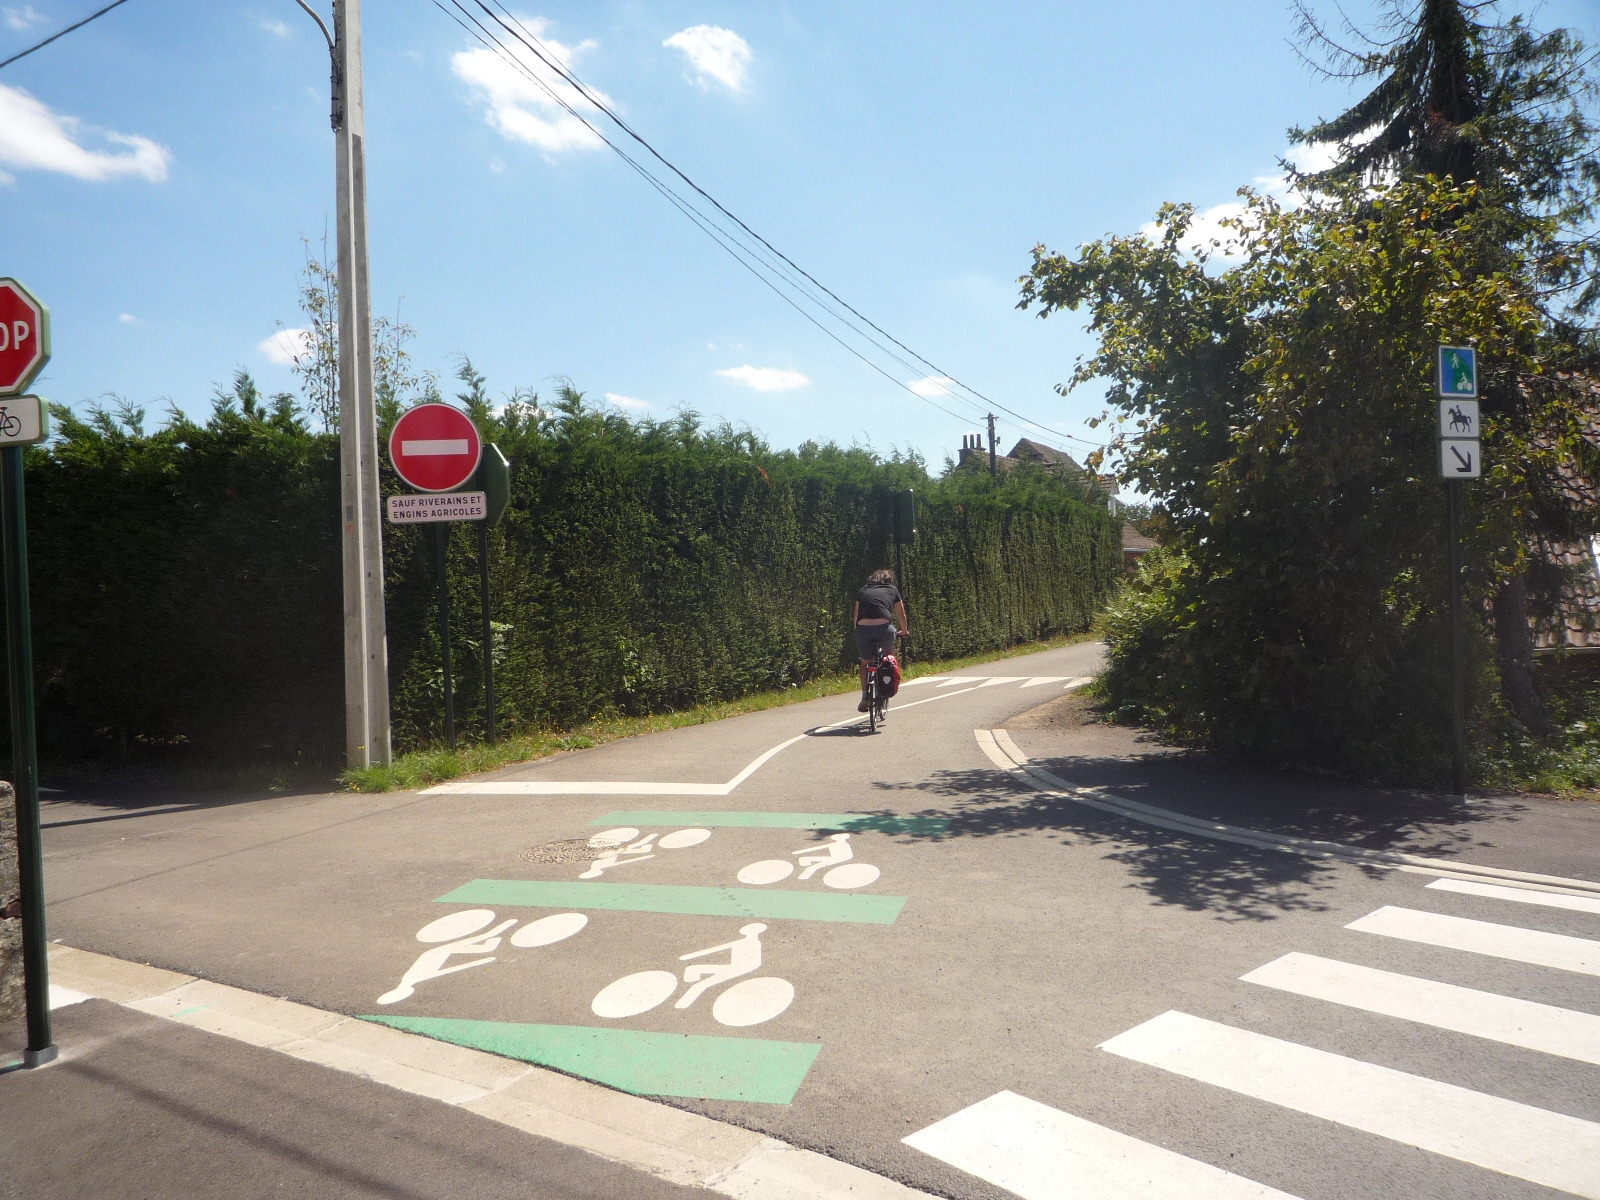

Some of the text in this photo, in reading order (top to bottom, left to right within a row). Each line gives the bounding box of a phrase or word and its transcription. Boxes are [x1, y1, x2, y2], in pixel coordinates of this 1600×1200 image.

[392, 496, 482, 508] SAUF RIVERAINS ET
[393, 507, 482, 519] ENGINS AGRICOLES
